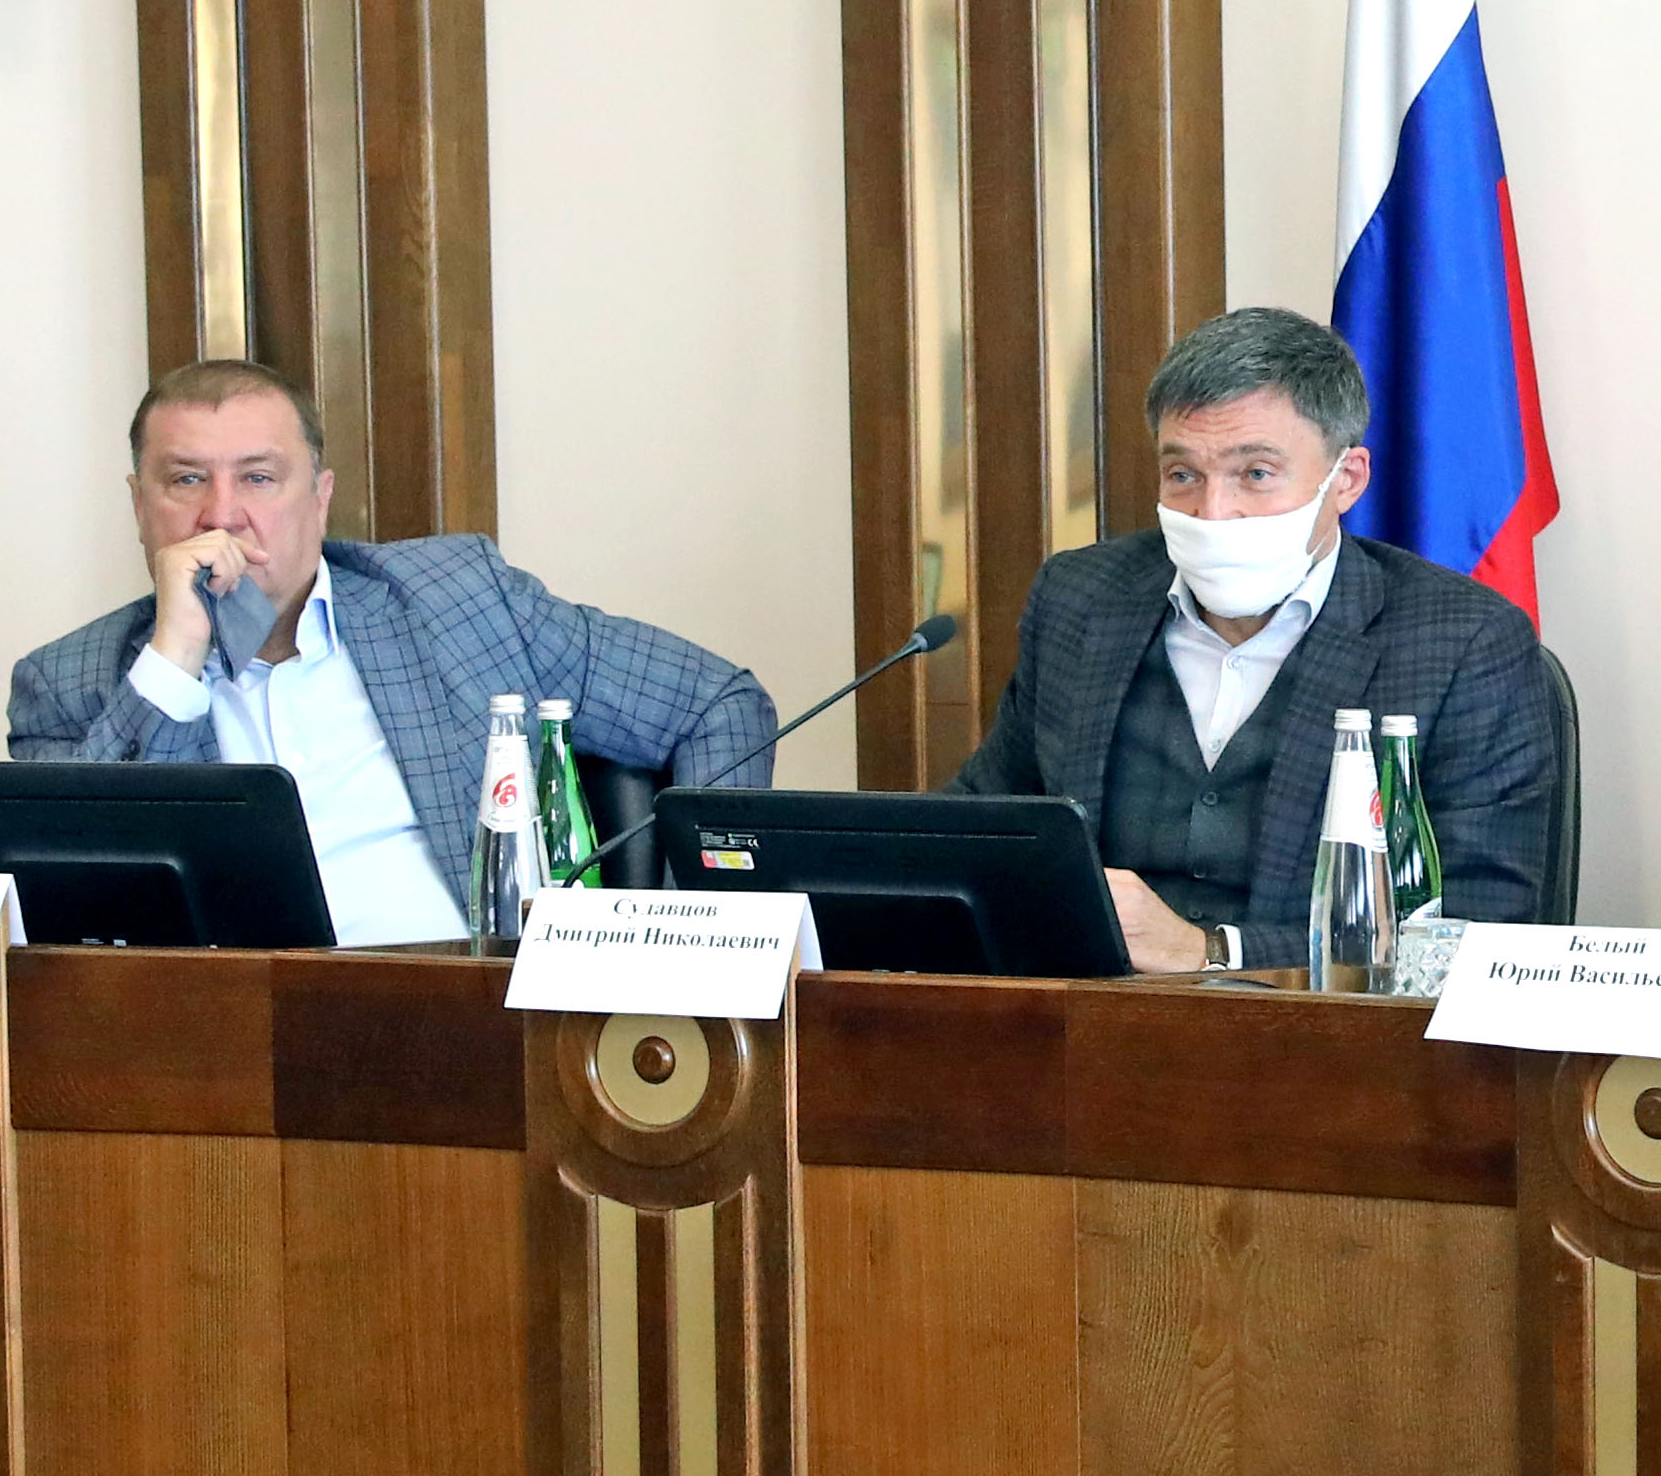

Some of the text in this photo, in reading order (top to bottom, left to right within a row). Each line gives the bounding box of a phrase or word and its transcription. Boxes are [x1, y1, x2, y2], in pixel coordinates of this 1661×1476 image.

[613, 898, 718, 919] Судавцов
[534, 923, 780, 950] Дмитрий Николаевич
[1568, 935, 1647, 955] Белый
[1488, 961, 1561, 986] Юрий
